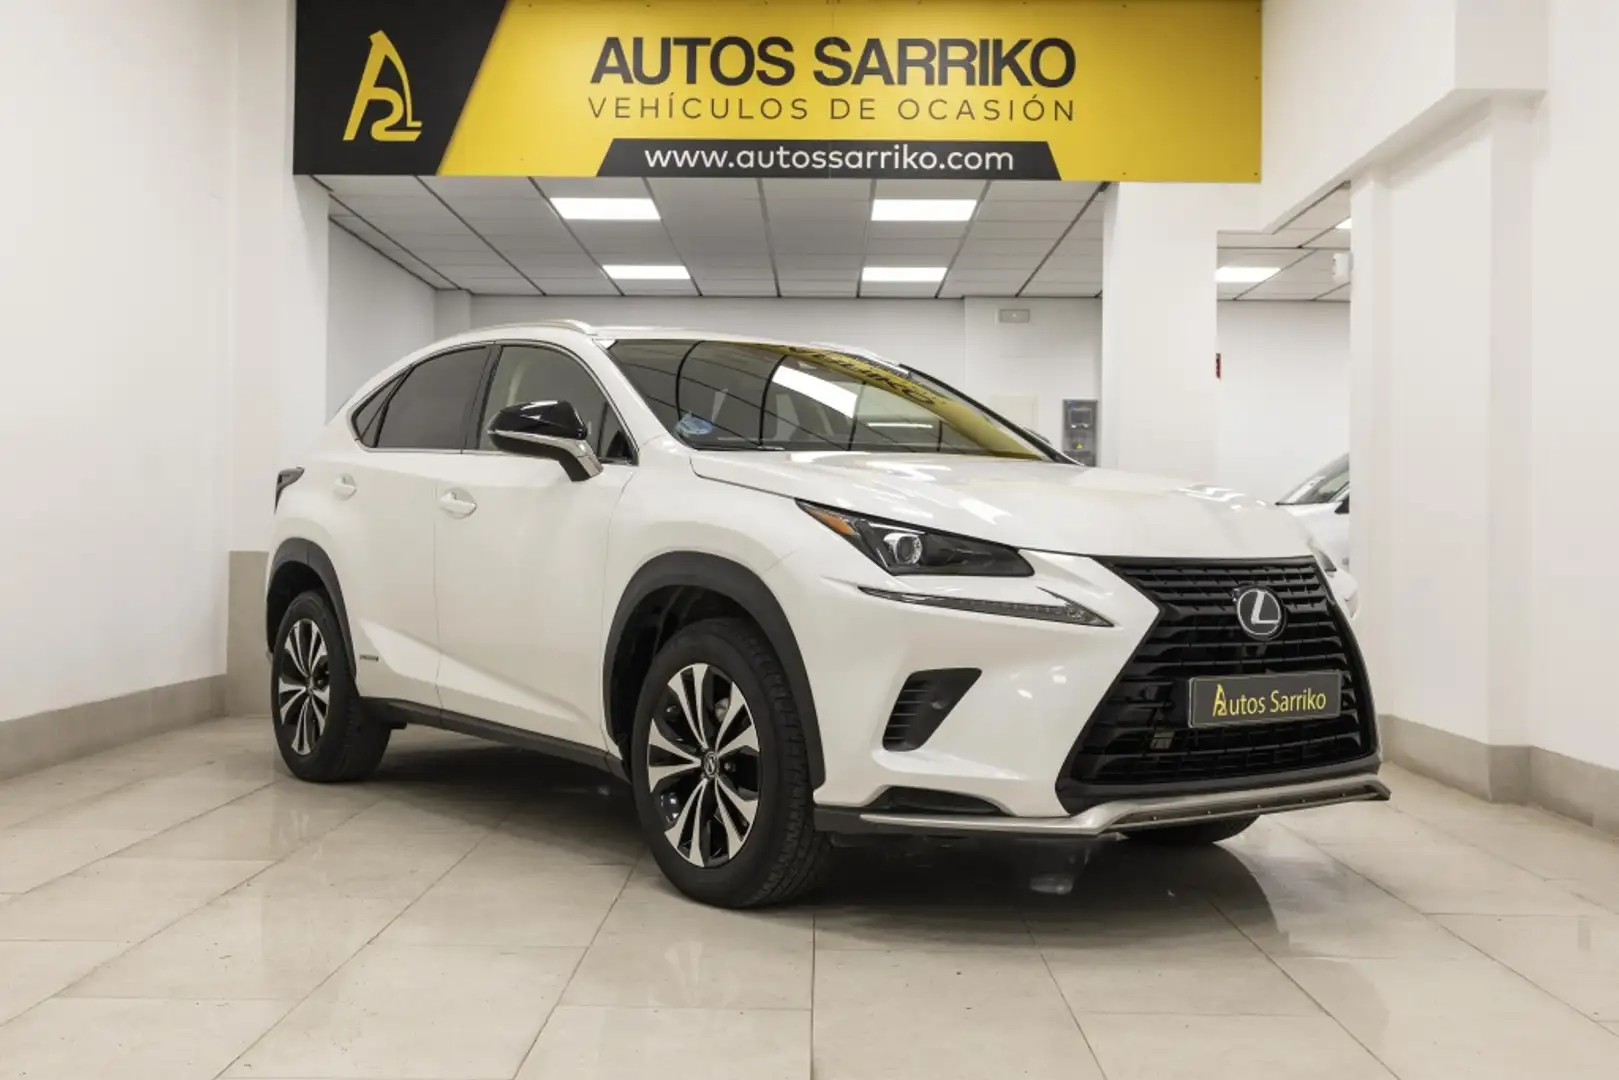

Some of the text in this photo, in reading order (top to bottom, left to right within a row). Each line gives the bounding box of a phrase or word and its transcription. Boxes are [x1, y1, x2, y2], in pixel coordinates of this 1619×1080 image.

[591, 36, 1077, 88] AUTOS SARRIKO
[588, 93, 1075, 123] VEHÍCULOS DE OCASIÓN
[643, 144, 1014, 171] www.autossarriko.com
[1212, 683, 1327, 717] Autos Sarriko
